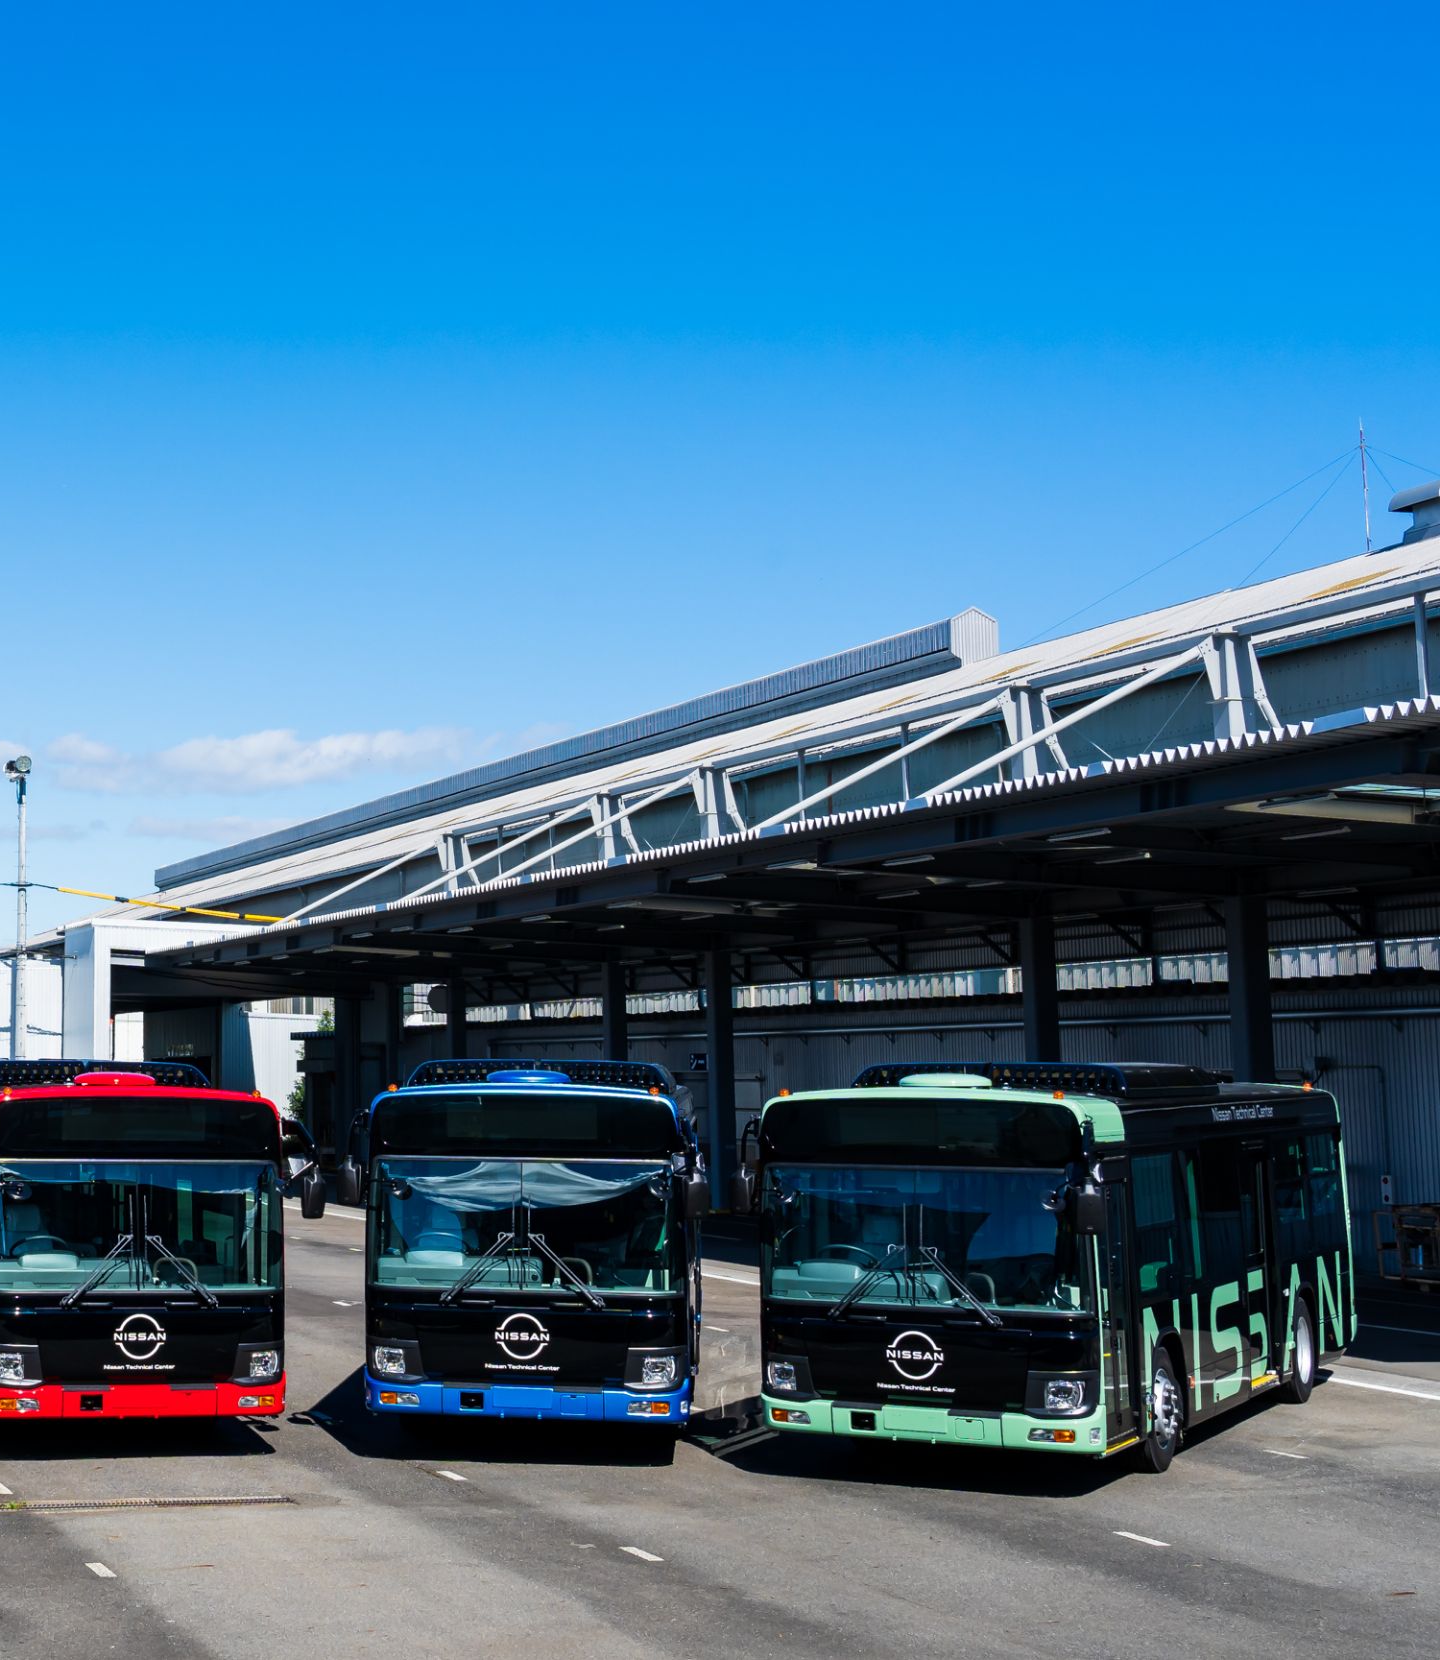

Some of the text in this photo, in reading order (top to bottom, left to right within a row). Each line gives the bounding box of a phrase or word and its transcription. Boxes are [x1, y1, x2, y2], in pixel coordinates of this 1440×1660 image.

[1211, 1104, 1273, 1121] Nissan Technical Center
[113, 1332, 166, 1341] NISSAN
[494, 1331, 550, 1342] NISSAN
[886, 1349, 944, 1361] NISSAN
[507, 1363, 537, 1371] Technical
[900, 1383, 932, 1391] Technical
